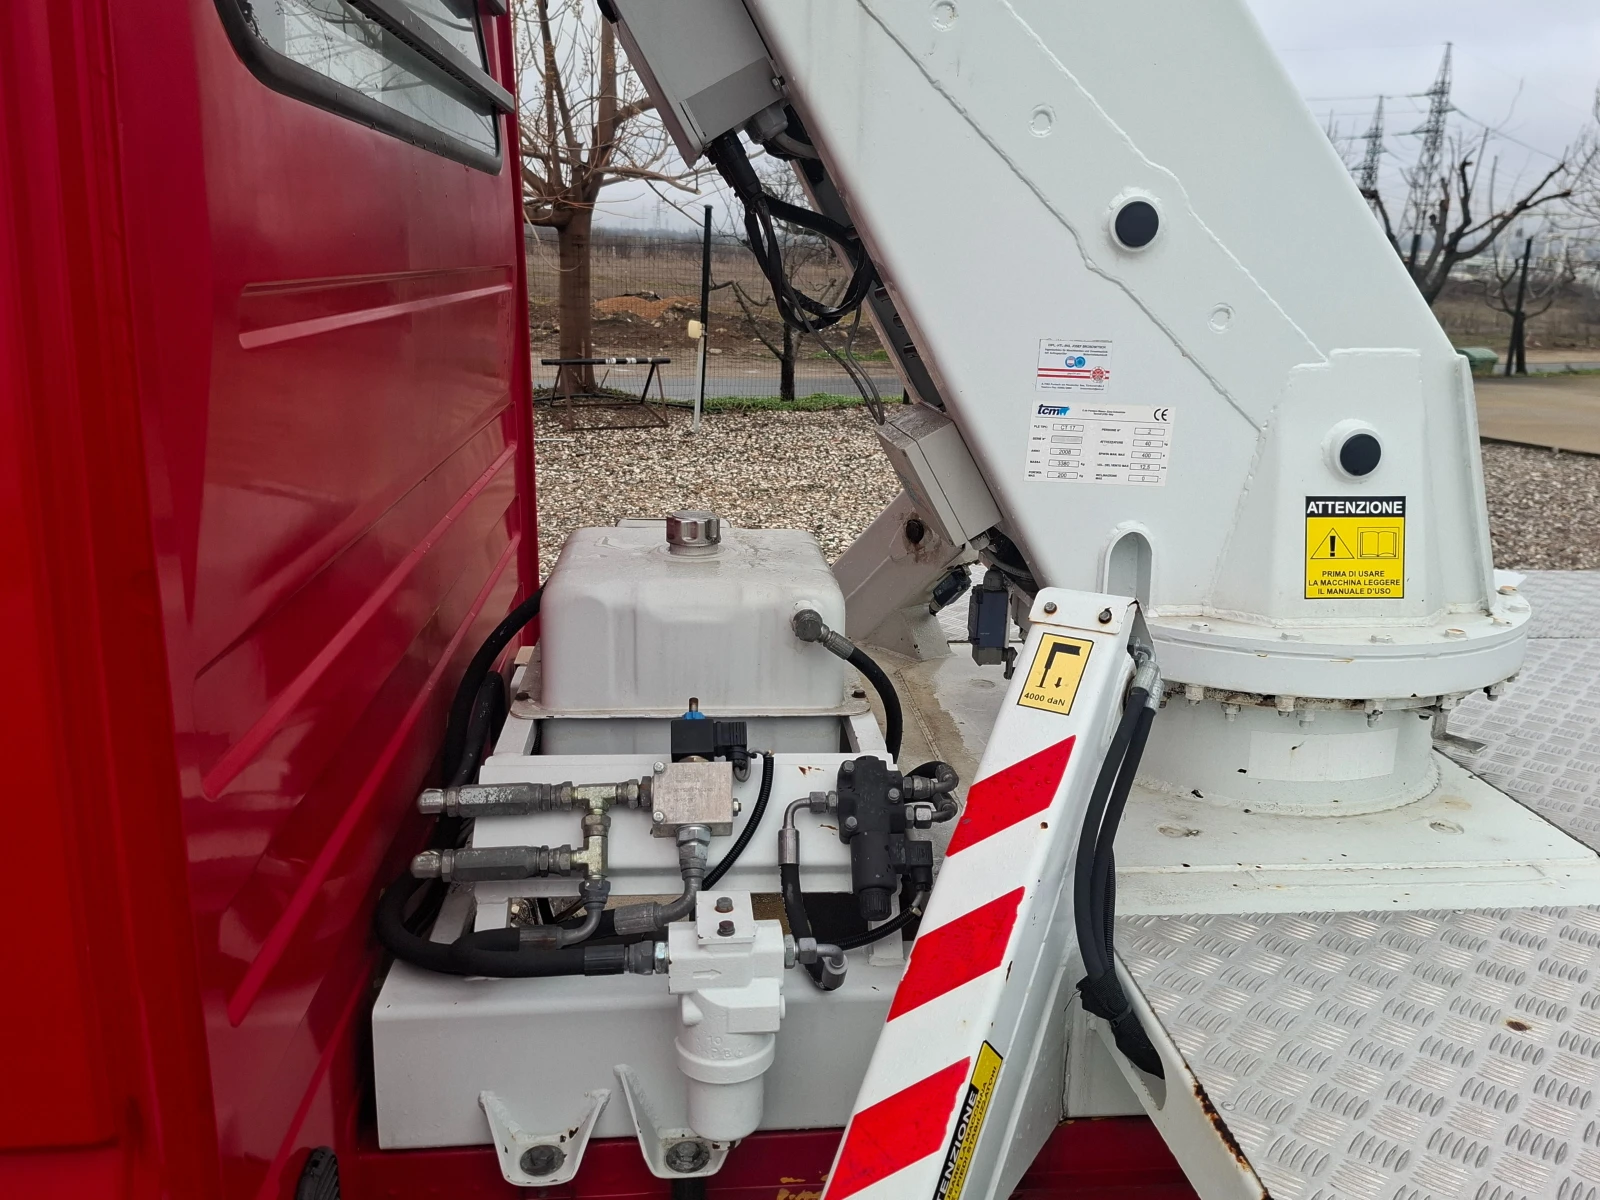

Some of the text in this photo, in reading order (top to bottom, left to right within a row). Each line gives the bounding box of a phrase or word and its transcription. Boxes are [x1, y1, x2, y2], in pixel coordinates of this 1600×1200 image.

[1154, 408, 1168, 422] CE
[1306, 501, 1403, 514] ATTENZIONE
[1024, 692, 1066, 706] 4000 daN
[966, 1082, 987, 1142] MACCHINA
